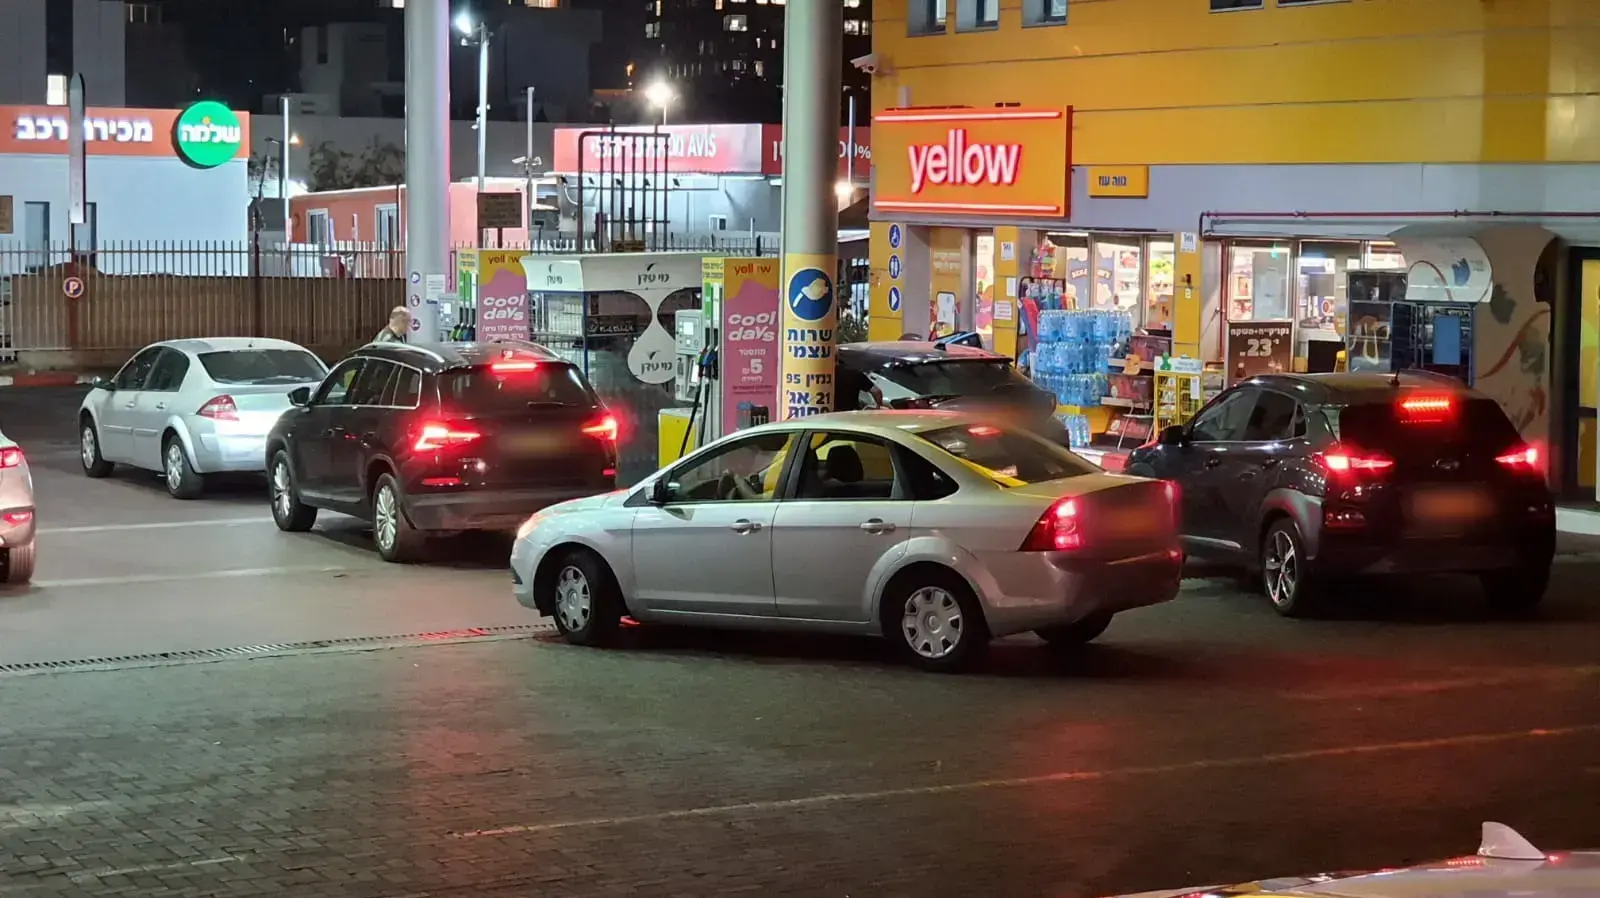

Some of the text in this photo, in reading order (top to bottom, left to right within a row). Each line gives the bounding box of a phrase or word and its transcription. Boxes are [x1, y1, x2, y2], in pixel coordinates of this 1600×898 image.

[17, 115, 69, 140] רכב
[180, 123, 241, 143] שלמה
[687, 133, 717, 158] AVIS
[907, 128, 1022, 193] yellow
[488, 254, 520, 265] yellw
[734, 263, 772, 276] yellw
[483, 294, 525, 307] cool
[728, 311, 776, 326] cool
[787, 328, 832, 341] שרות
[788, 345, 831, 359] עצמי
[751, 358, 763, 374] 5
[786, 373, 832, 387] בנזין 95
[815, 391, 831, 404] 21
